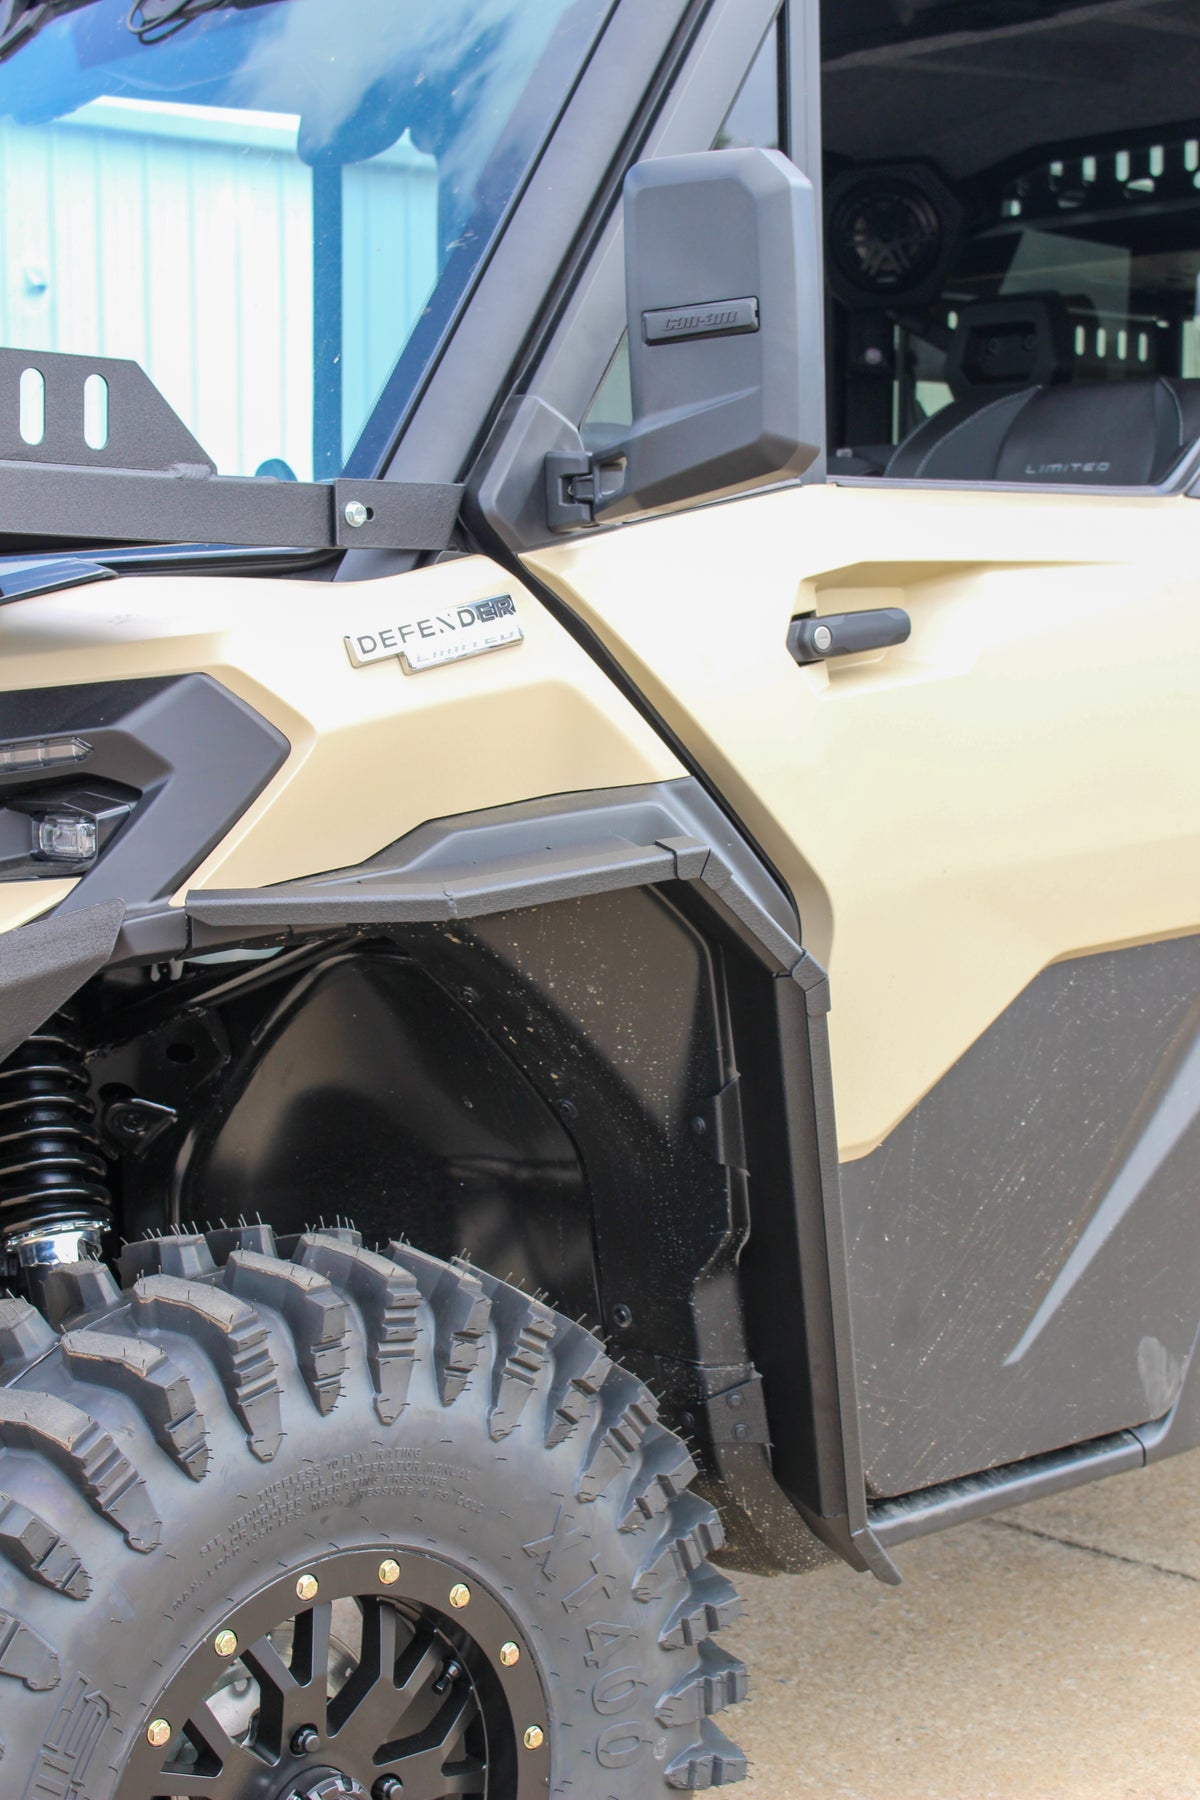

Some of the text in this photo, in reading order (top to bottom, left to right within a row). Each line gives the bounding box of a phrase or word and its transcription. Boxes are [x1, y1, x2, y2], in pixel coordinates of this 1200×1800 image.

[1024, 461, 1111, 475] LIMITED
[356, 594, 515, 655] DEFENDER
[257, 1463, 320, 1500] TUBELESS
[343, 1450, 366, 1466] PLY
[375, 1447, 422, 1460] RATING
[350, 1485, 413, 1501] PRESSURE
[199, 1460, 472, 1558] SEE VEHICLE LABEL OR OPERATOR MANUAL
[222, 1473, 447, 1552] FOR PROPER OPERATING PRESSURE
